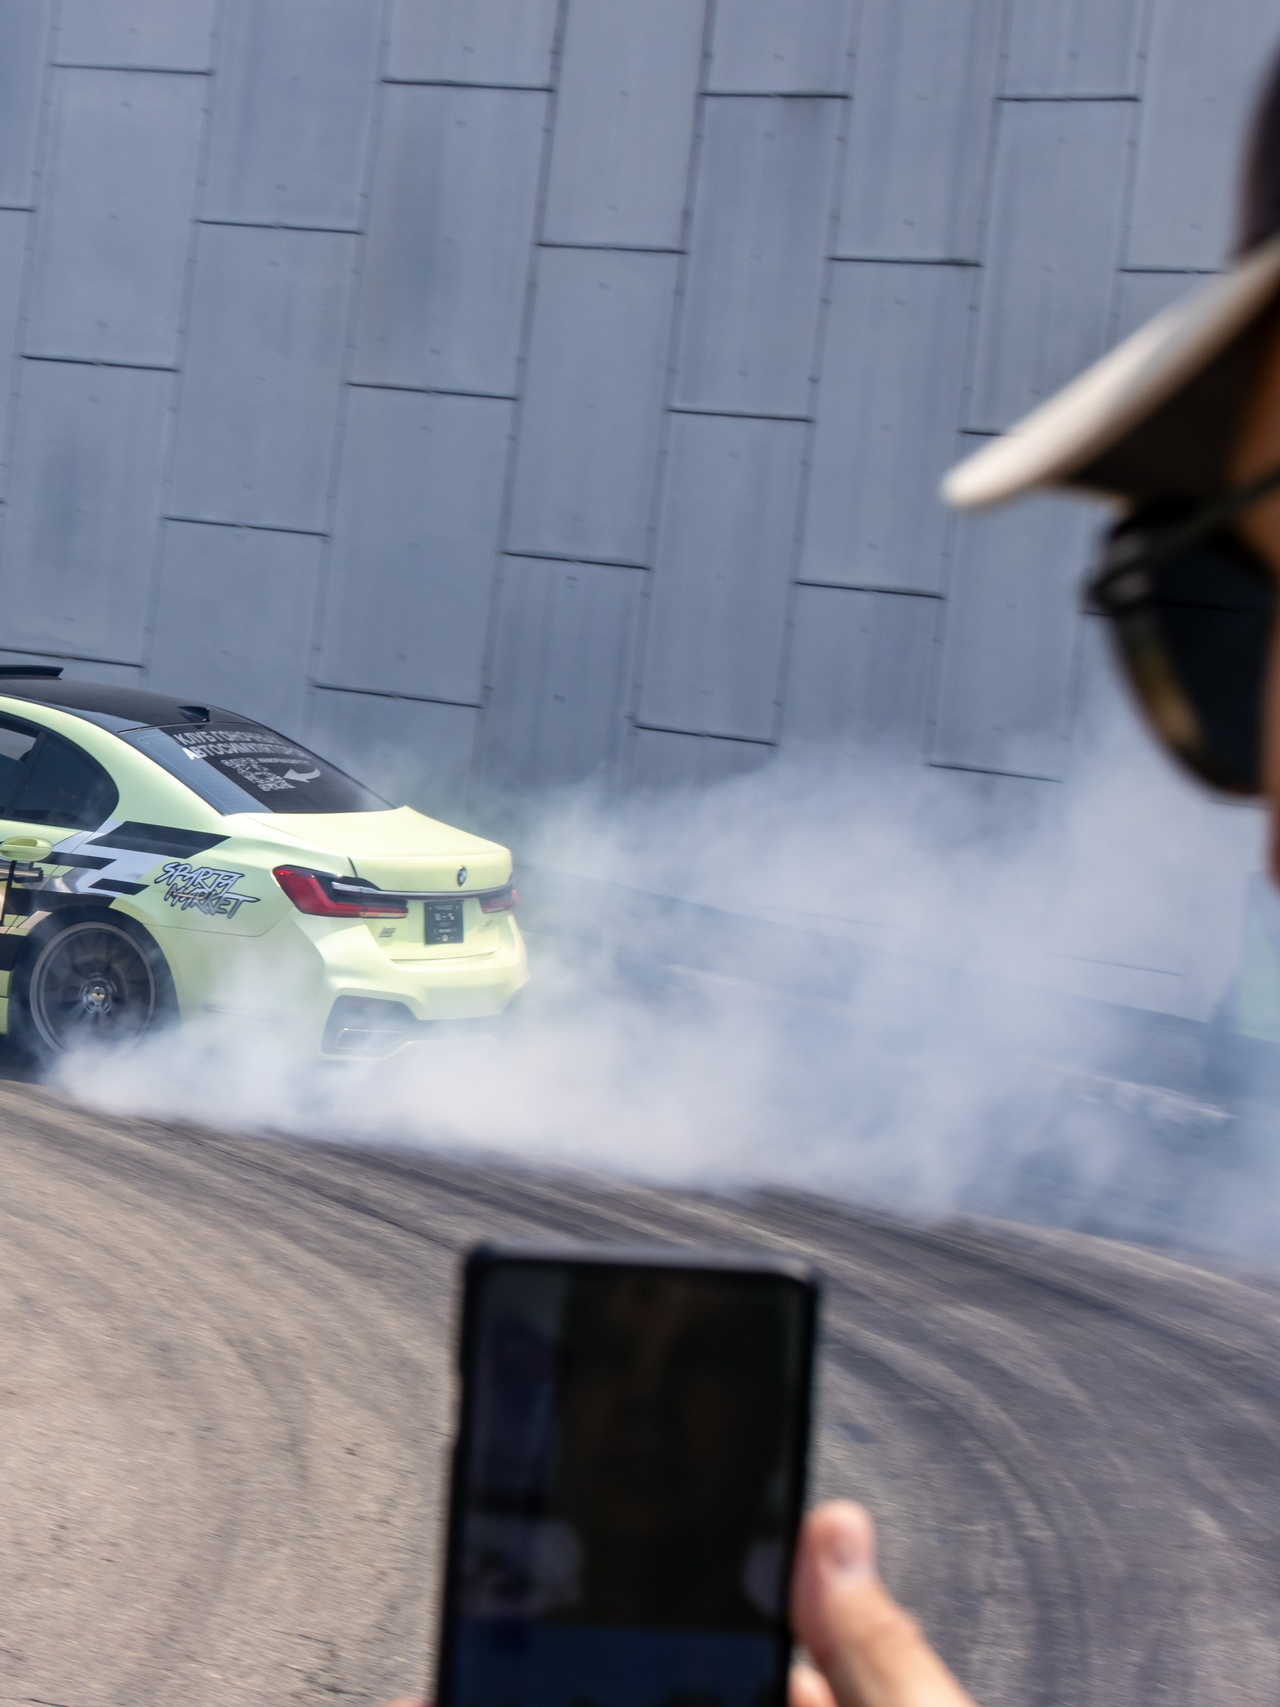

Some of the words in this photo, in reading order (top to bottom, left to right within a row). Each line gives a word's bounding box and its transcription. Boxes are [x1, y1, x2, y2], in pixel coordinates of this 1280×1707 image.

[173, 730, 217, 746] КЛУБ
[154, 862, 245, 897] SPARTA
[164, 883, 261, 919] MARKET
